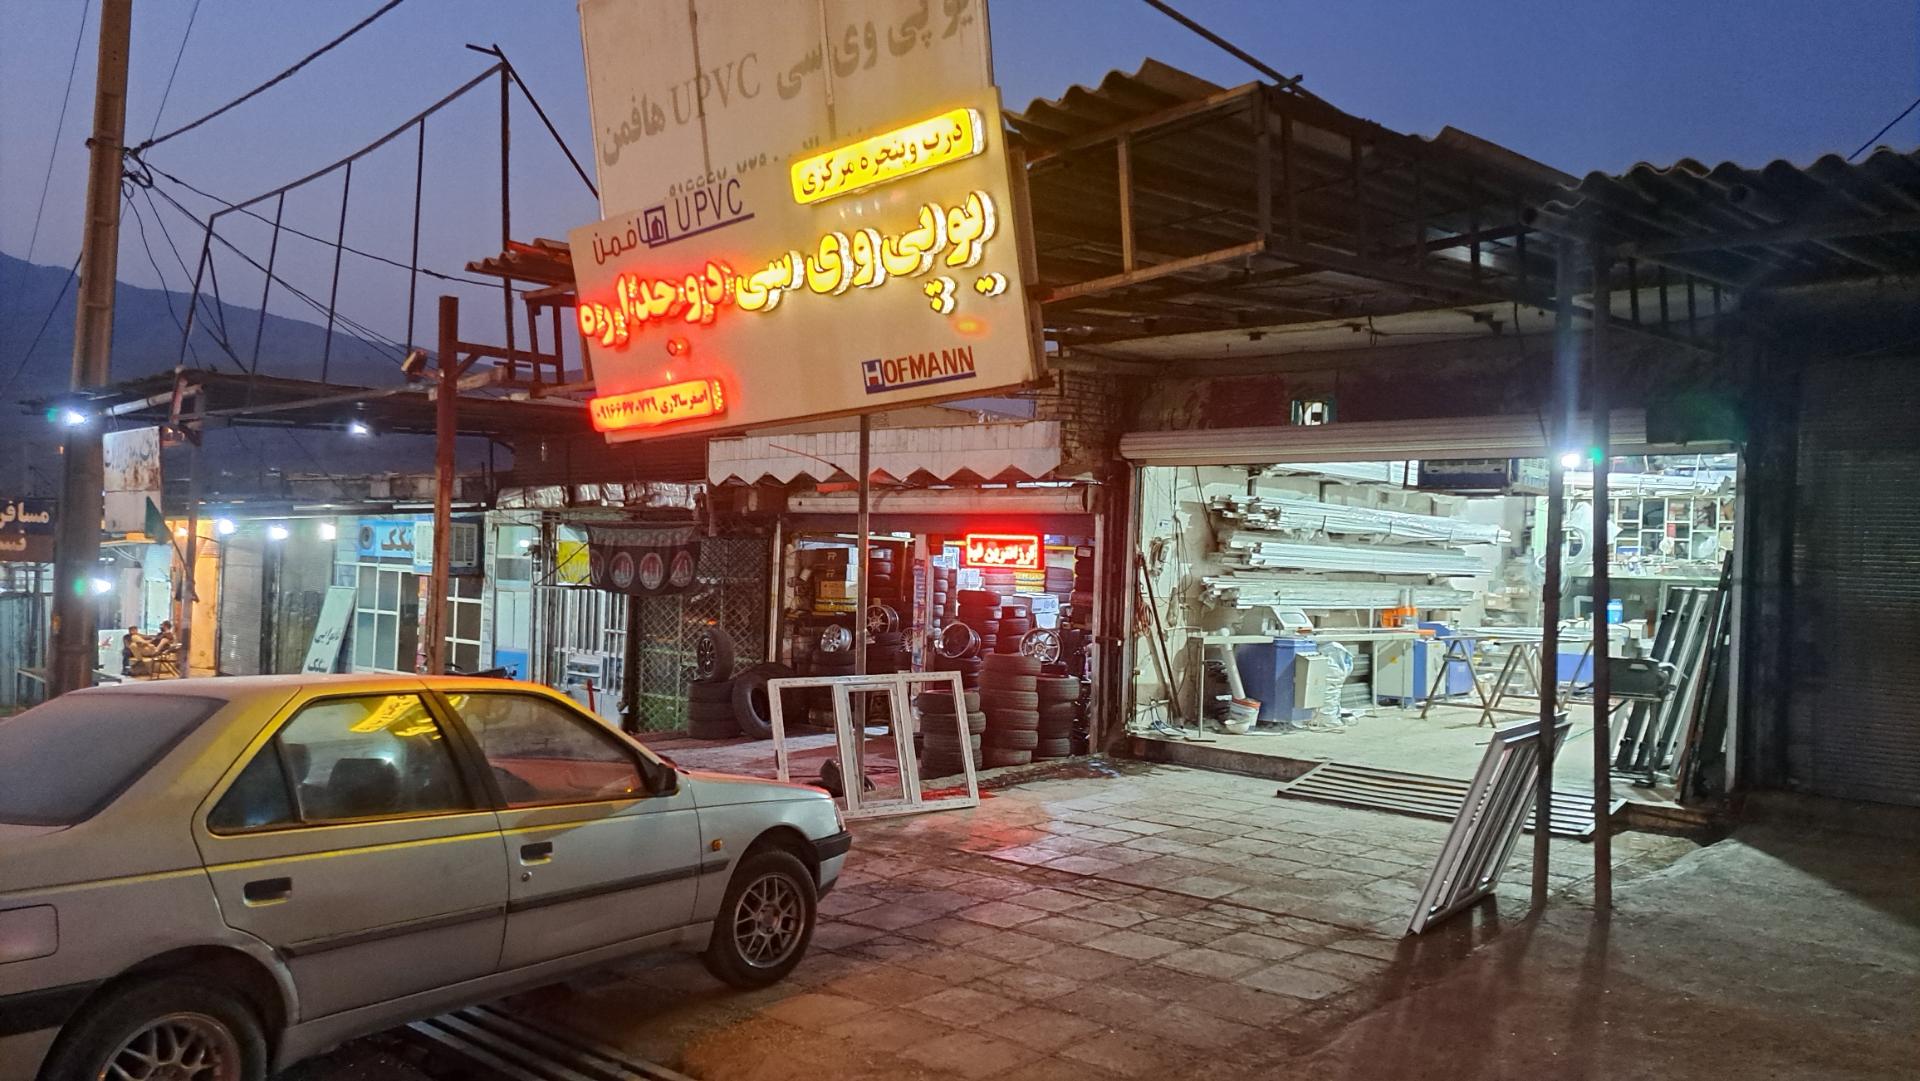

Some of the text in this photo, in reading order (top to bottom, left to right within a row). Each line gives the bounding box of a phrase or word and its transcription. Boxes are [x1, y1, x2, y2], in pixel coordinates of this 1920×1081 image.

[669, 52, 761, 125] UPVC
[776, 41, 824, 100] سی
[603, 92, 666, 167] هافمن
[923, 122, 963, 157] درب
[801, 157, 855, 196] مرکزی
[676, 178, 743, 233] UPVC
[735, 252, 803, 312] سی
[863, 345, 976, 390] HOFMANN
